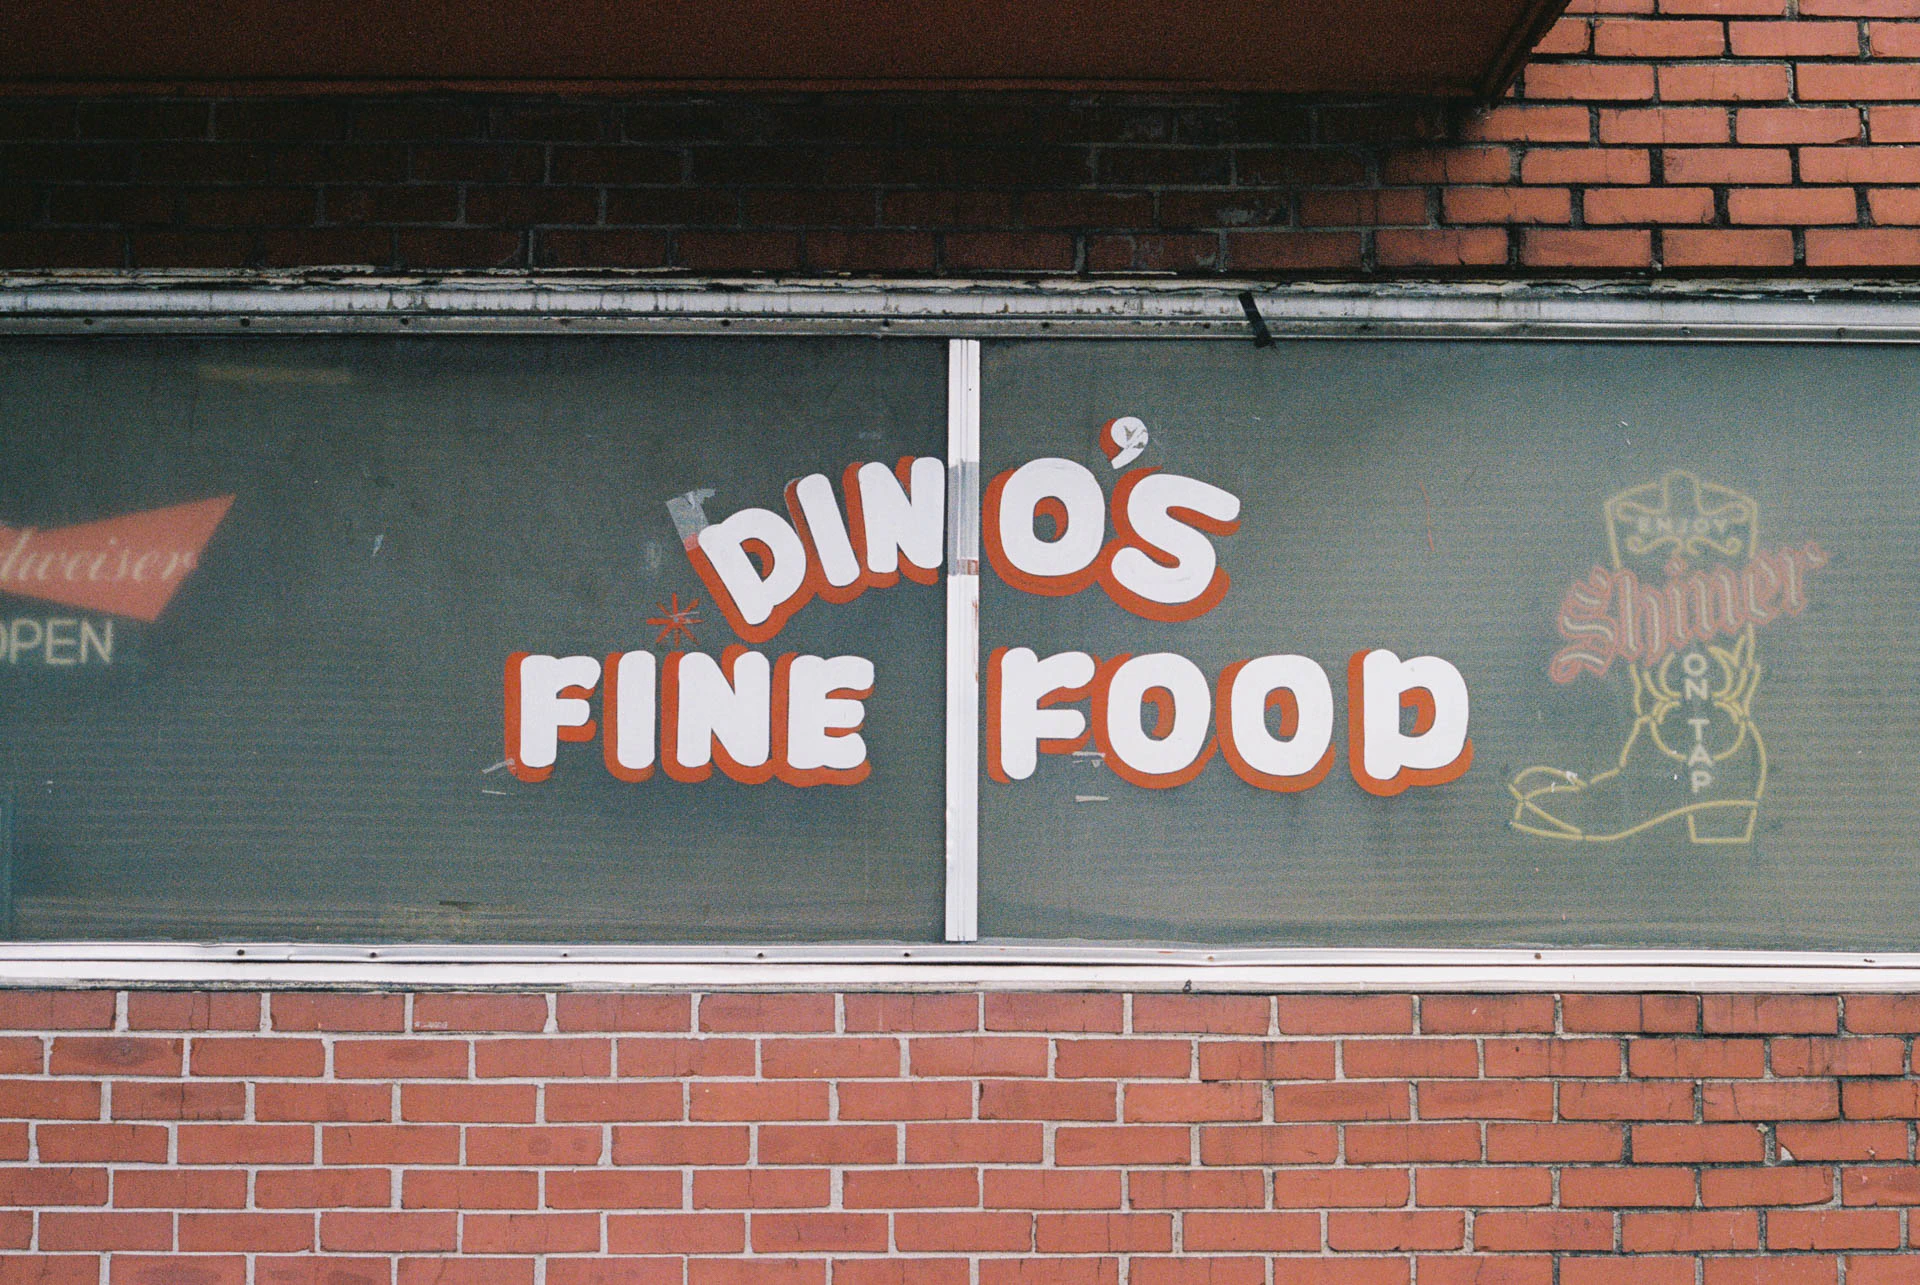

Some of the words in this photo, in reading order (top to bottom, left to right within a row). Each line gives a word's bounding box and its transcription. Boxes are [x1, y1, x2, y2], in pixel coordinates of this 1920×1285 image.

[683, 416, 1242, 643] DINO'S
[1637, 516, 1728, 534] ENJOY
[0, 618, 113, 664] PEN
[1550, 540, 1829, 684] Shiner
[1682, 653, 1710, 700] ON
[504, 644, 876, 787] FINE
[986, 646, 1474, 797] FOOD
[1686, 718, 1714, 793] TAP
